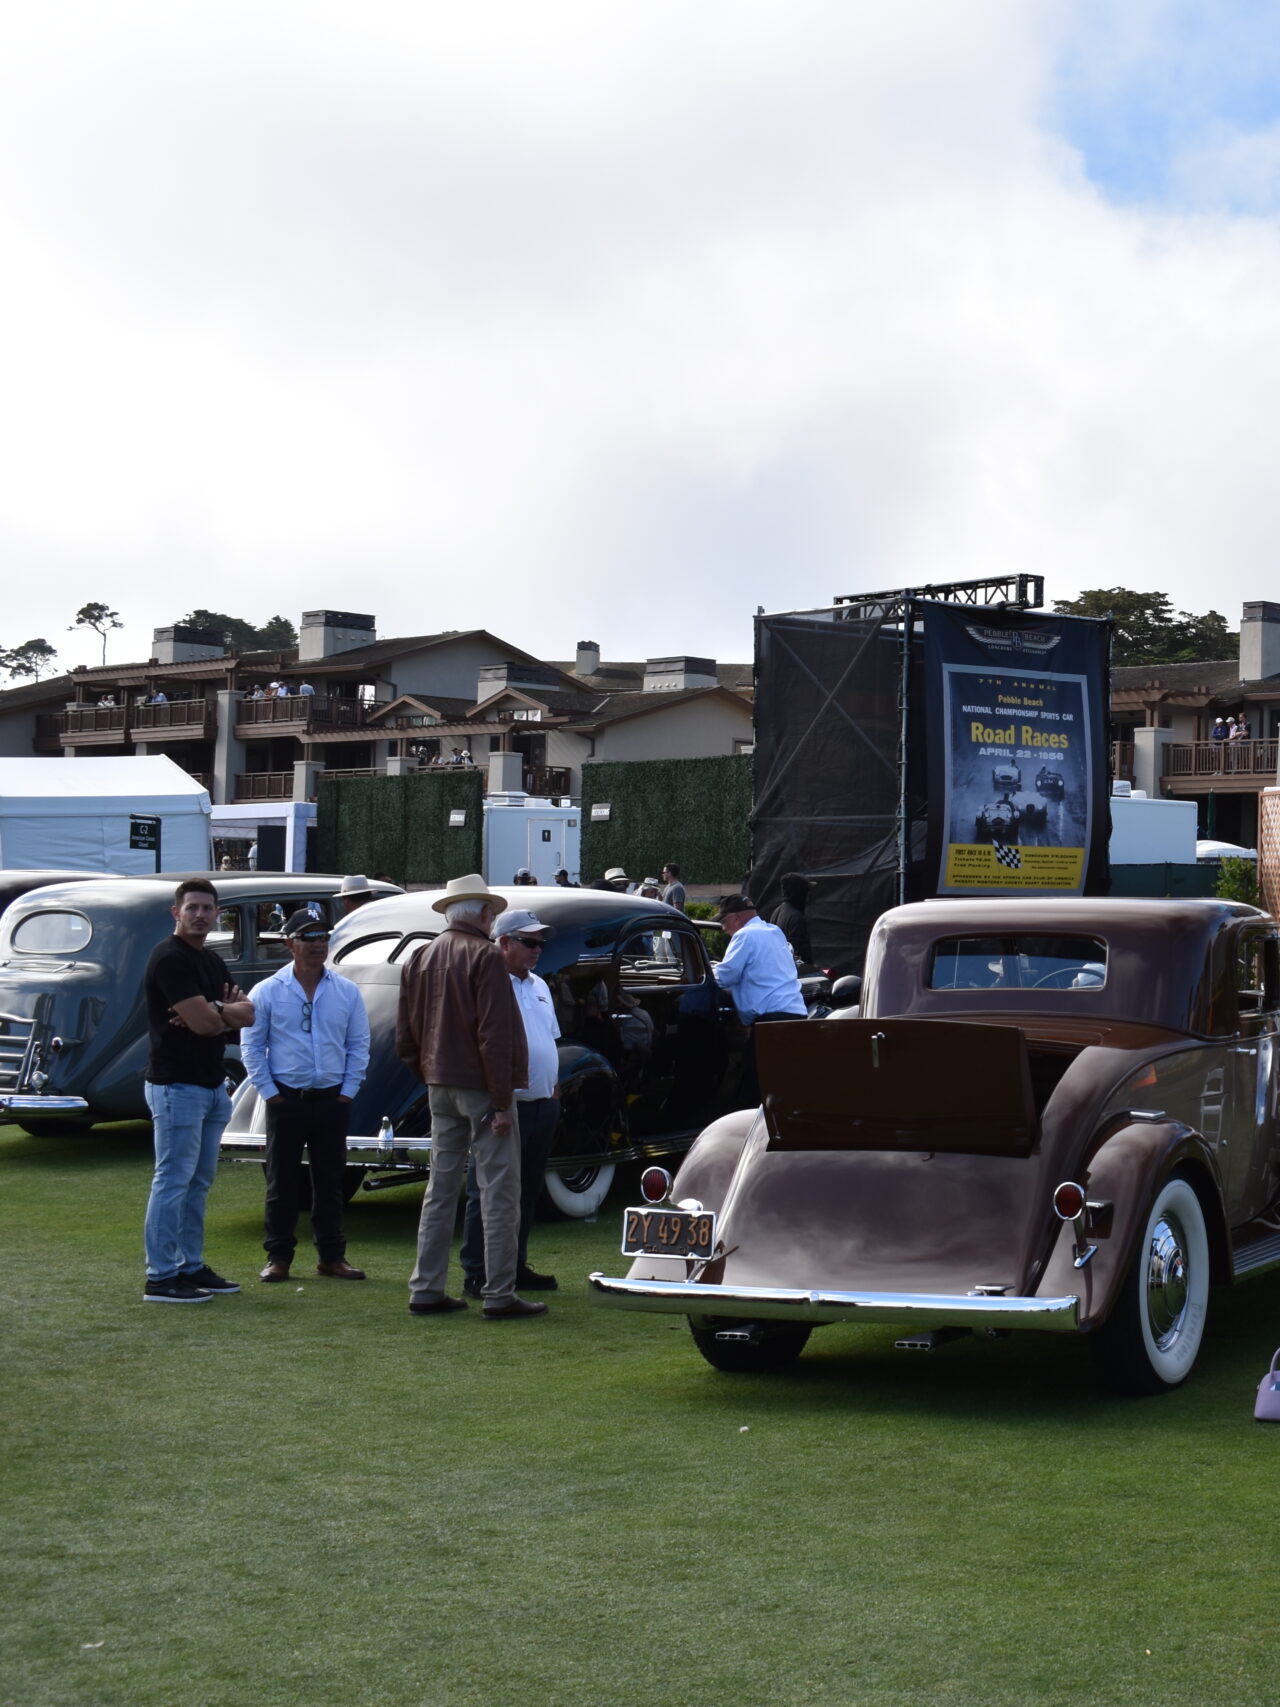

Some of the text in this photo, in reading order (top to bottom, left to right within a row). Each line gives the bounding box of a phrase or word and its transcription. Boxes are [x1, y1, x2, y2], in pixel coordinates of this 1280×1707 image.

[1014, 681, 1056, 691] ANNUAL
[998, 694, 1044, 707] Pebble Beach
[962, 704, 1074, 721] NATIONAL CHAMPIONSHIP SPORTS CAR
[971, 721, 1069, 749] Road Races
[978, 747, 1064, 761] APRIL 22 1956
[627, 1215, 711, 1247] 2Y 49 38
